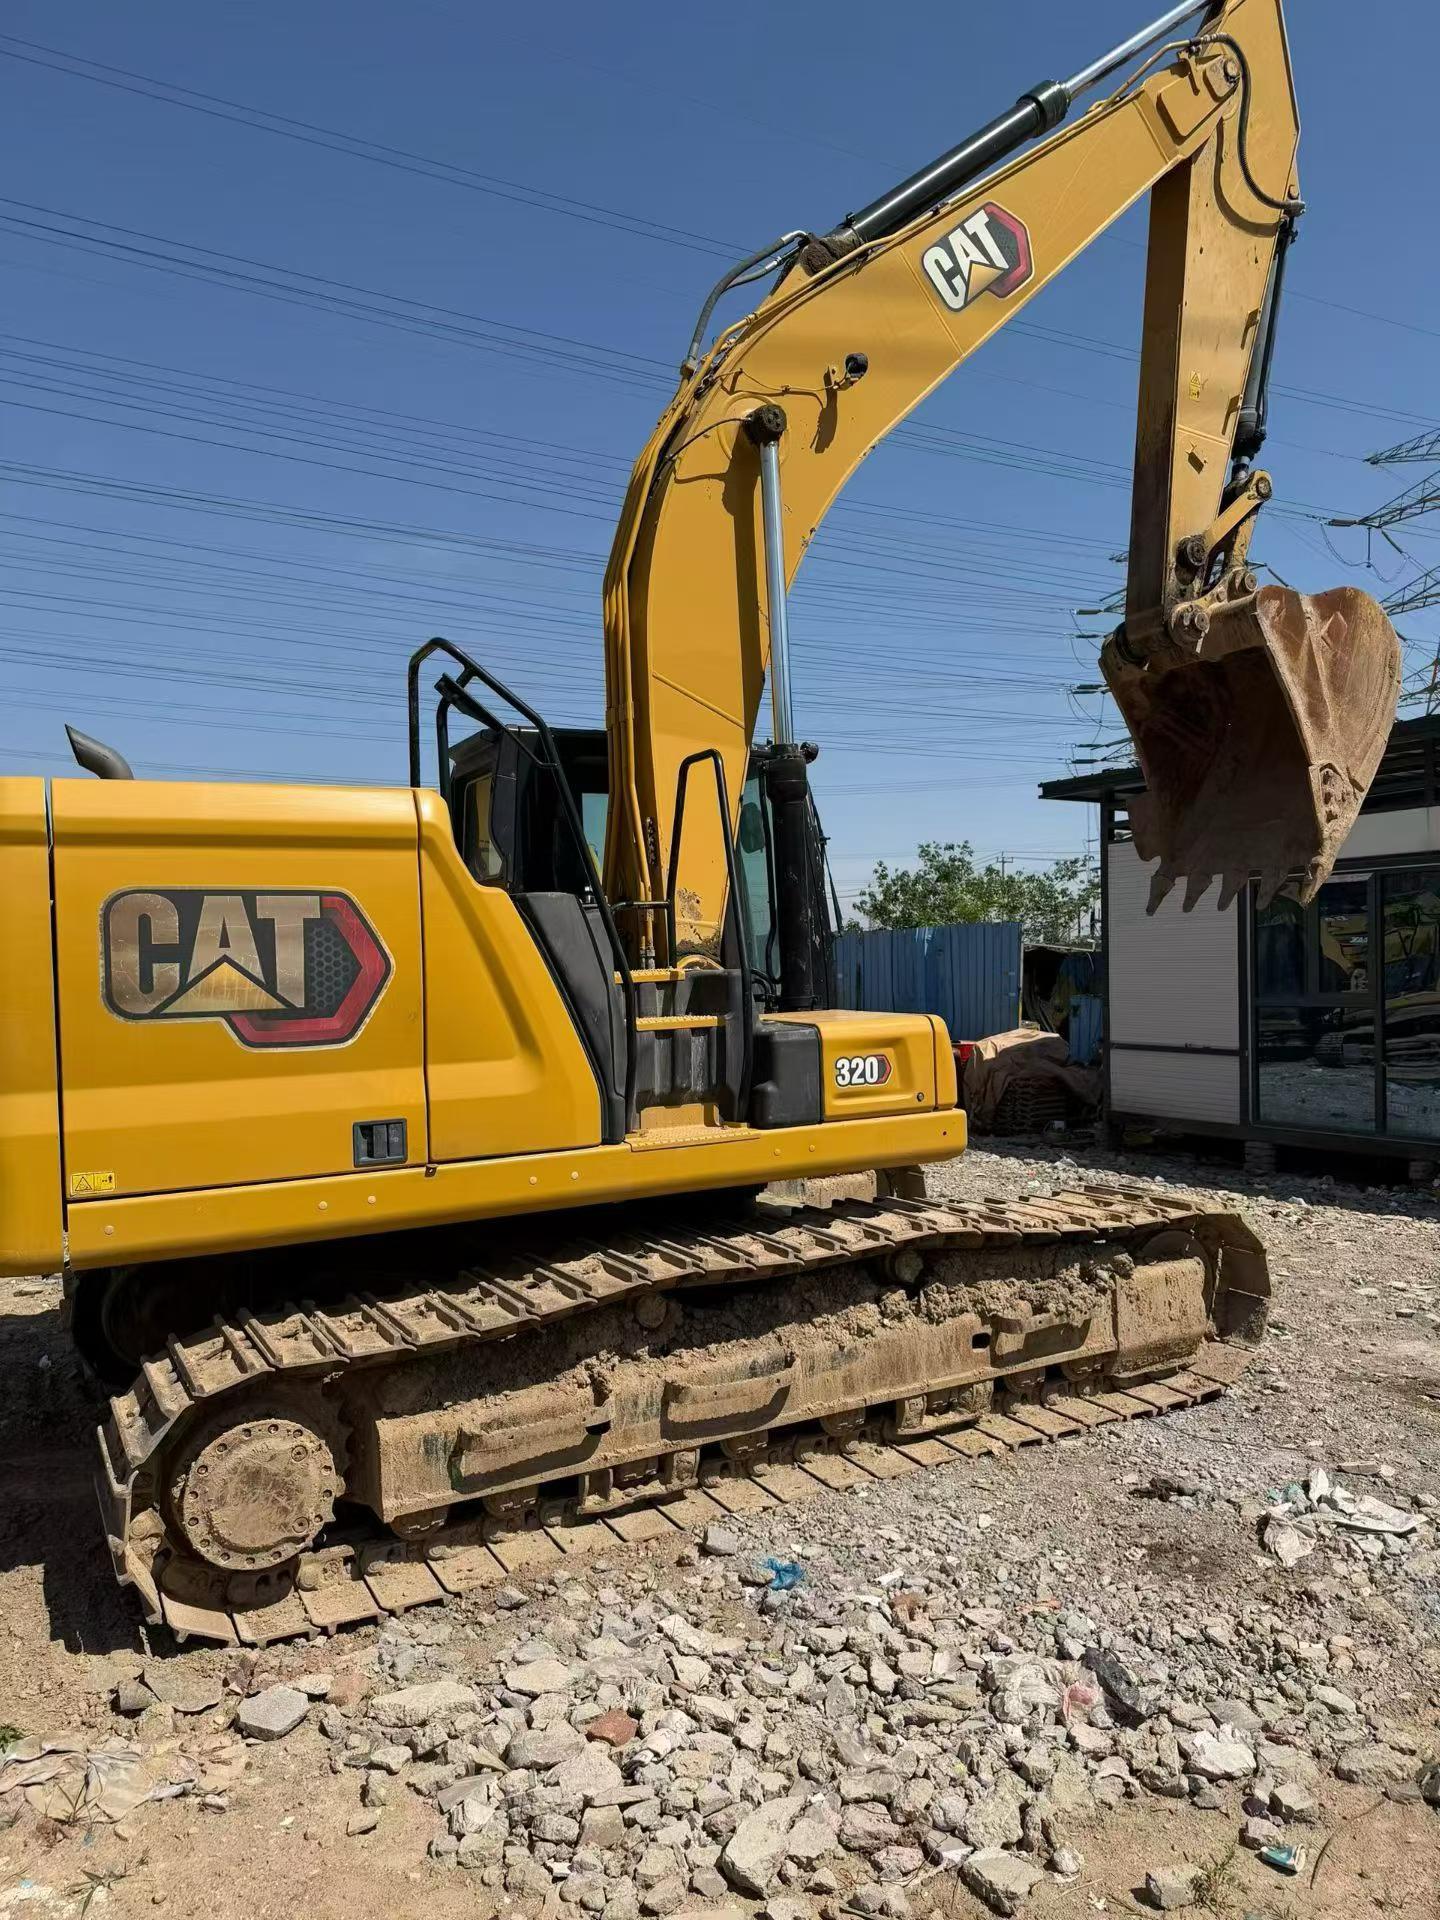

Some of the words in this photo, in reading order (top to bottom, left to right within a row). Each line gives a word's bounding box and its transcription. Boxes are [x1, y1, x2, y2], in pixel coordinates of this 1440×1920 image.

[923, 209, 1010, 309] CAT
[109, 893, 321, 1014] CAT
[836, 1056, 879, 1086] 320
